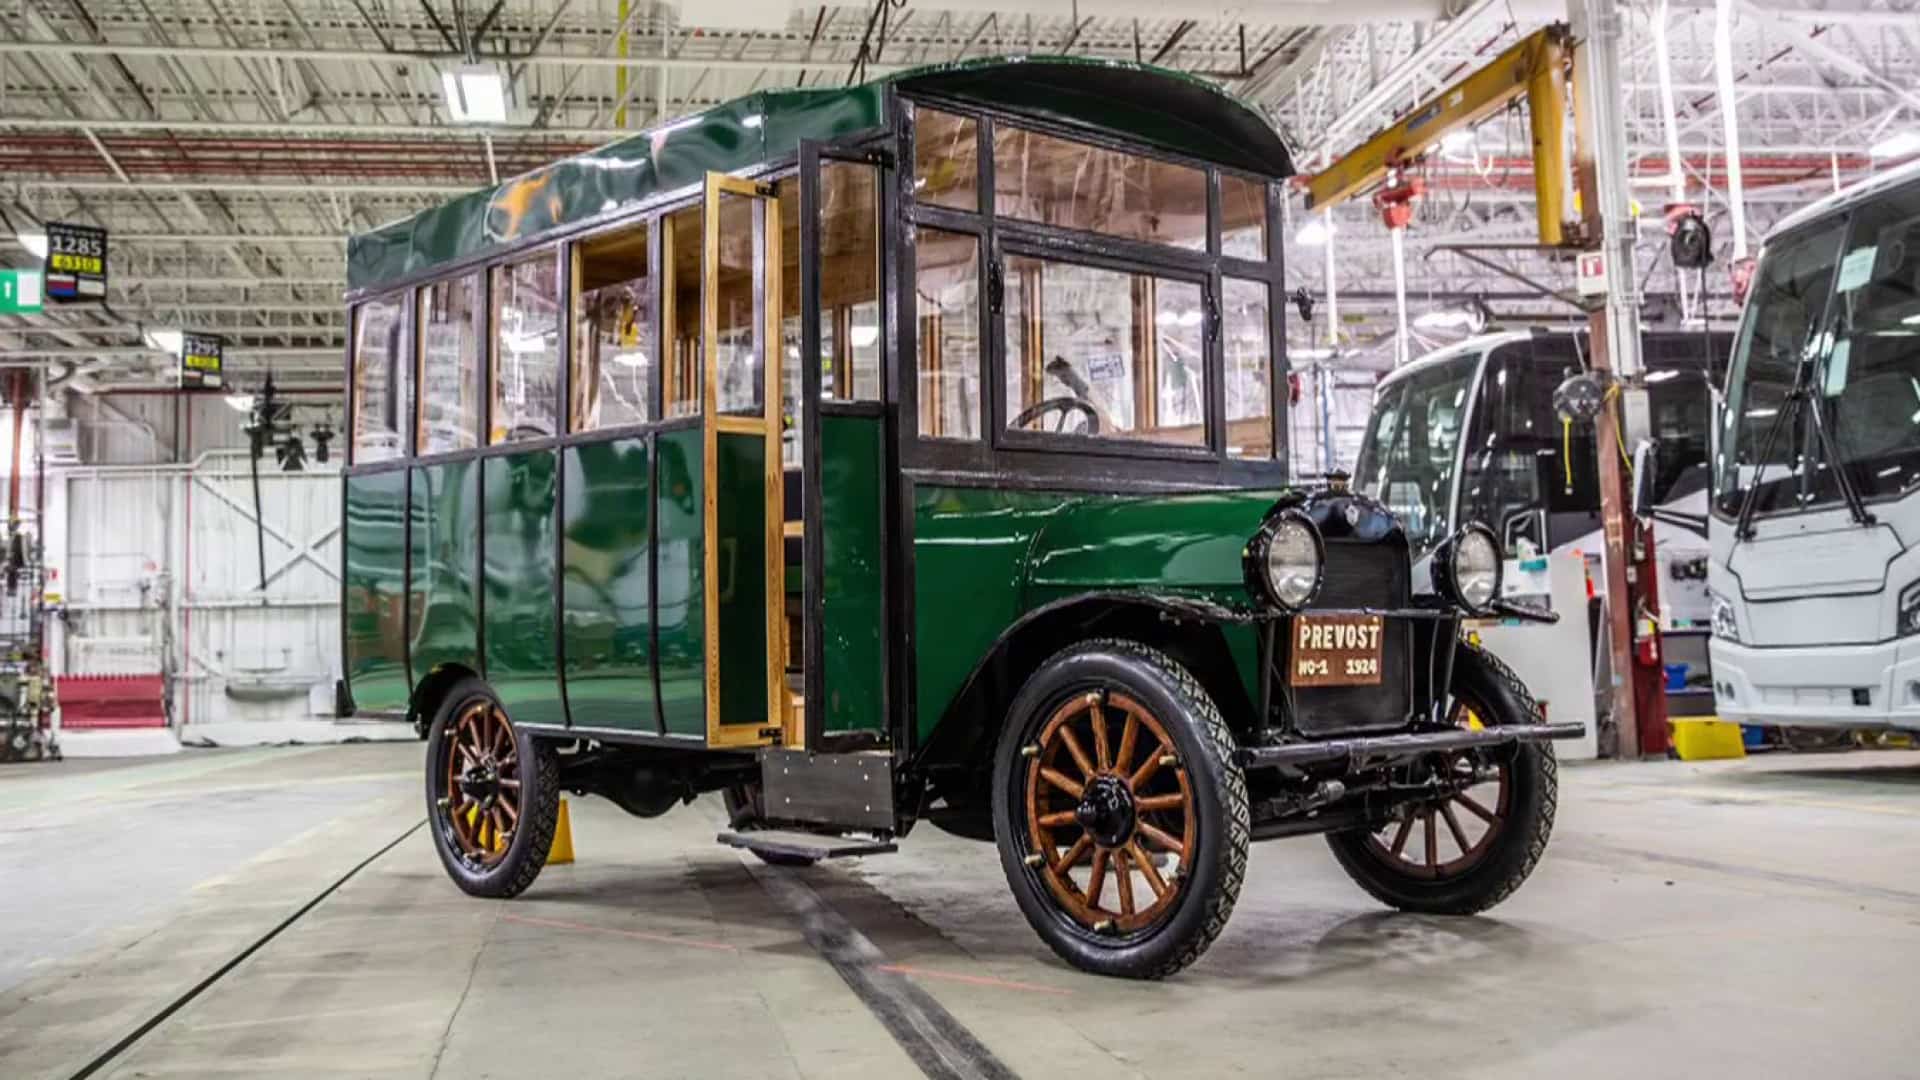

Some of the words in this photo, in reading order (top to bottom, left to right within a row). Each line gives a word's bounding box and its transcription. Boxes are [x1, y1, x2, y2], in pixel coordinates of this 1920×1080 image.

[52, 236, 102, 257] 1285
[1300, 624, 1380, 649] PREVOST
[1346, 658, 1377, 675] 1924
